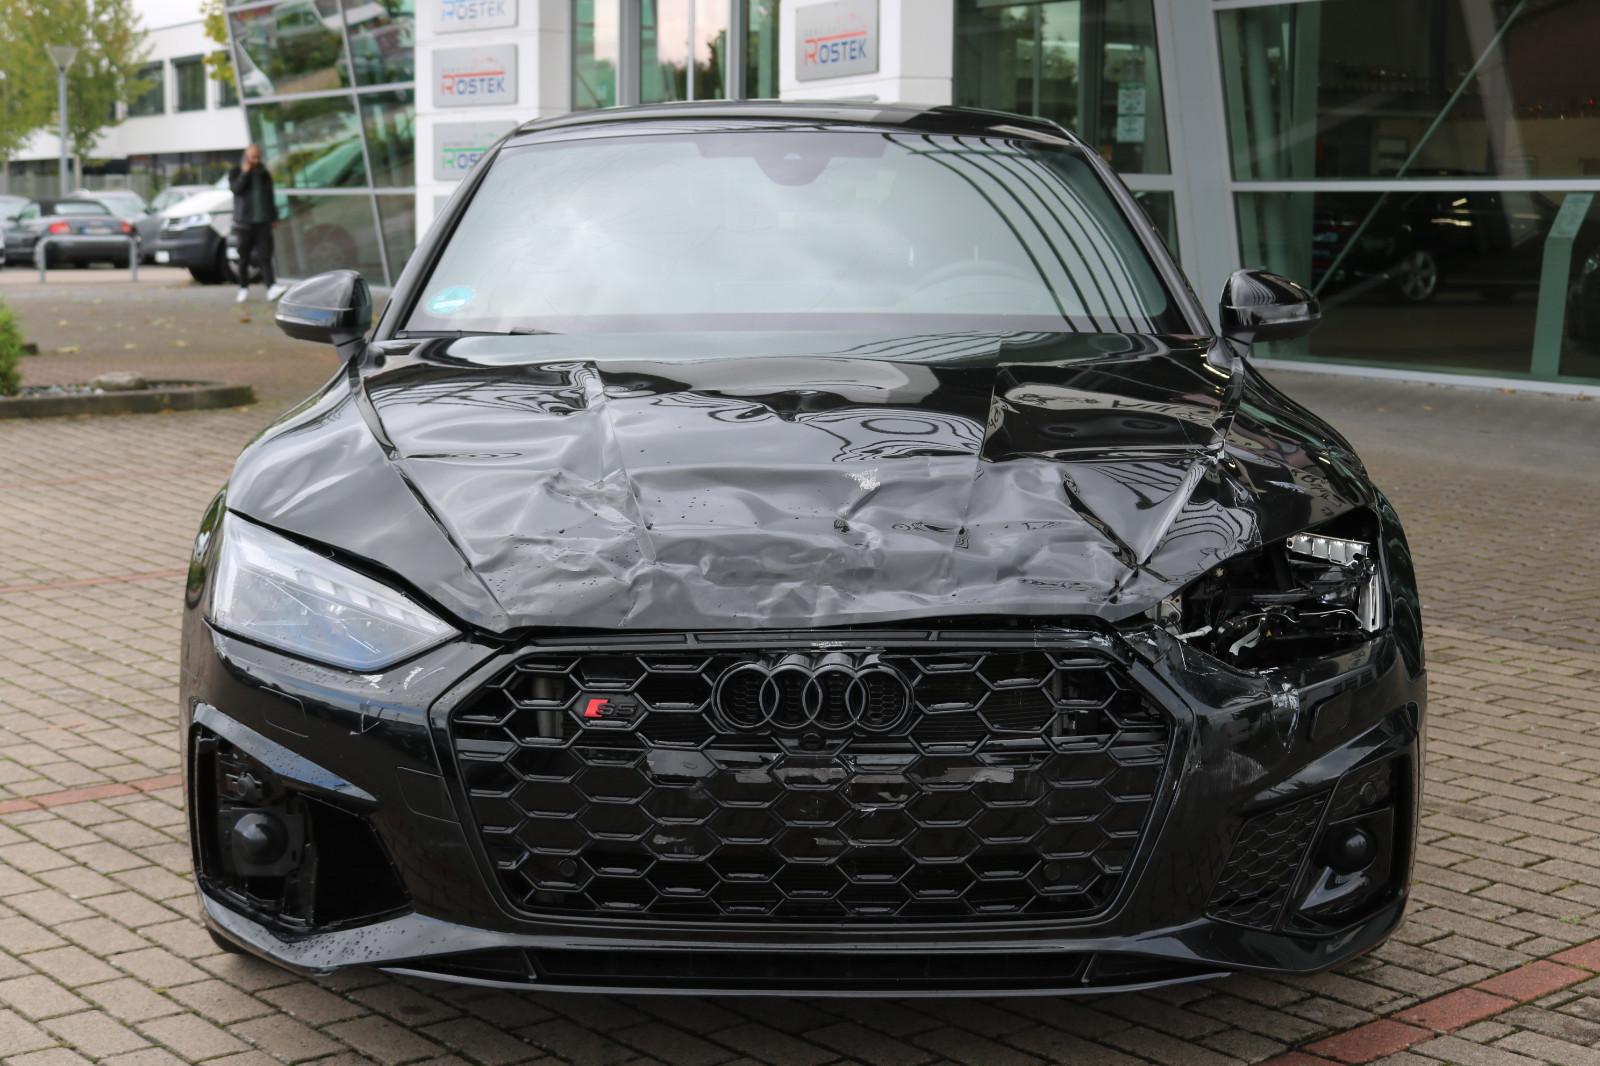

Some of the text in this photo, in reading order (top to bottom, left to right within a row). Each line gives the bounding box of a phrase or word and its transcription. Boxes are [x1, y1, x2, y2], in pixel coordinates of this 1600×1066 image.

[804, 36, 867, 64] ROSTEK
[441, 75, 505, 95] ROSTEK
[442, 151, 480, 169] ROS
[589, 700, 637, 716] S5
